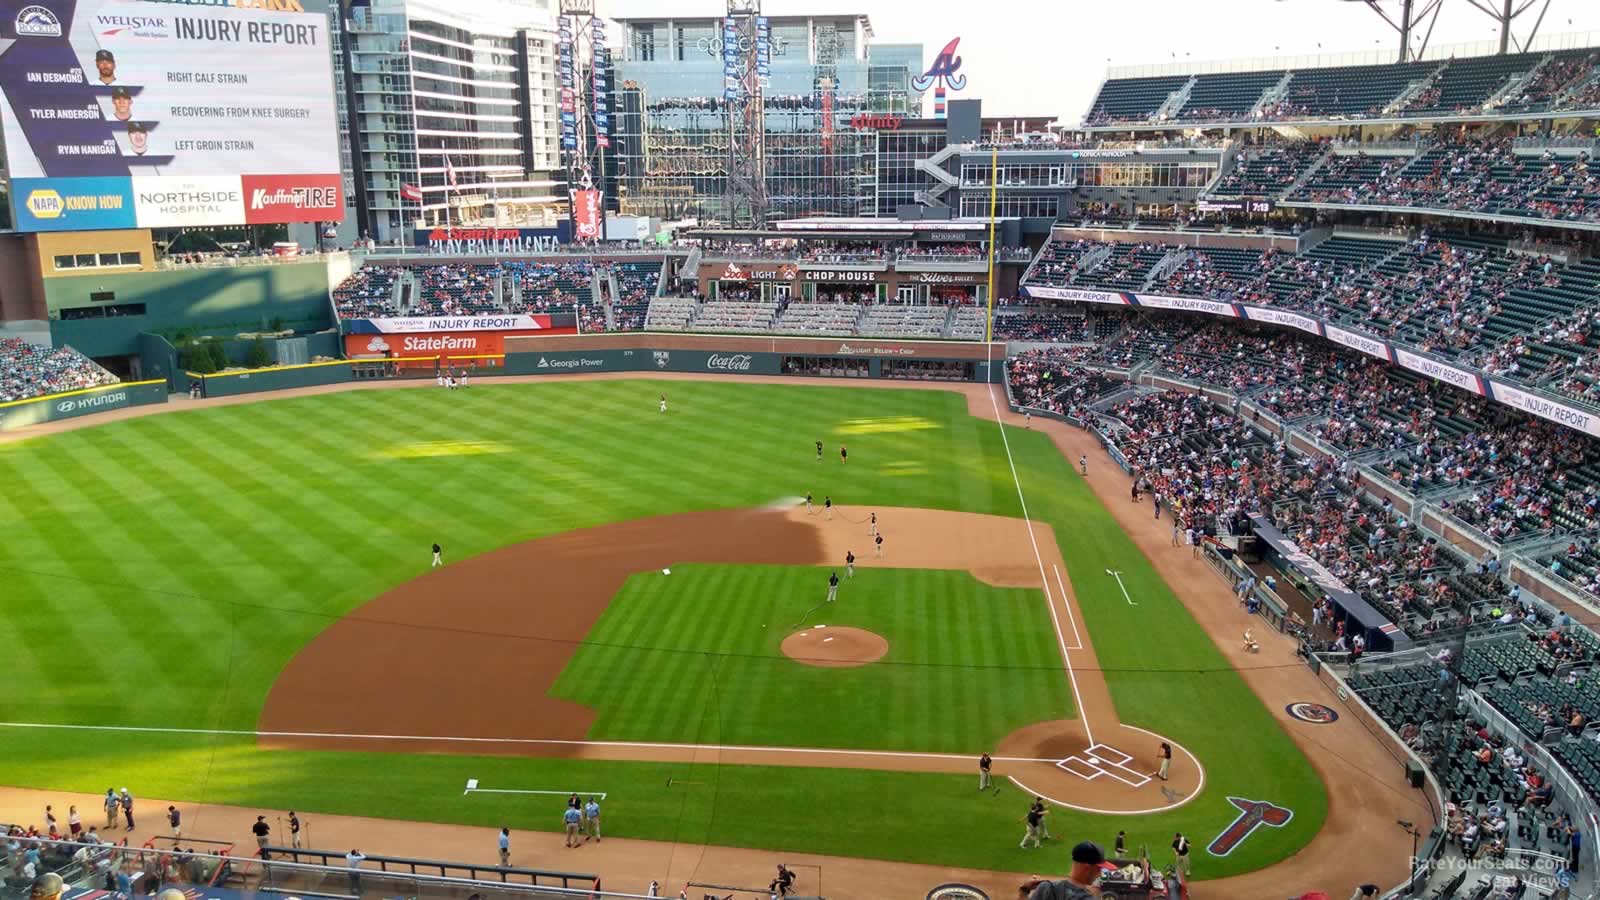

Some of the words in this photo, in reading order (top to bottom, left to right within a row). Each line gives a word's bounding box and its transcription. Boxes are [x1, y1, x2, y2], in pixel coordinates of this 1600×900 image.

[97, 15, 165, 29] WELLSTAR
[175, 17, 241, 42] INJURY
[248, 21, 317, 45] REPORT
[27, 72, 41, 82] IAN
[43, 72, 83, 83] DESMOND
[167, 71, 193, 83] RIGHT
[195, 73, 215, 83] CALF
[217, 73, 248, 84] STRAIN
[30, 109, 56, 119] TYLER
[57, 109, 100, 119] ANDERSON
[171, 106, 225, 117] RECOVERING
[226, 107, 250, 118] FROM
[252, 107, 273, 118] KNEE
[274, 108, 311, 119] SURGERY
[850, 112, 903, 130] xfinity
[58, 145, 80, 155] RYAN
[81, 145, 116, 155] HANIGAN
[175, 140, 194, 150] LEFT
[196, 140, 223, 150] GROIN
[224, 140, 255, 151] STRAIN
[33, 197, 59, 211] NAPA
[66, 196, 97, 210] KNOW
[99, 195, 123, 209] HOW
[140, 191, 239, 205] NORTHSIDE
[252, 188, 305, 209] Kauffman
[292, 187, 336, 209] TIRE
[160, 205, 222, 214] HOSPITAL
[1252, 203, 1269, 212] 7:13
[751, 270, 776, 279] LIGHT
[806, 271, 835, 280] CHOP
[838, 271, 875, 281] HOUSE
[920, 272, 953, 282] Silver
[1057, 290, 1082, 299] INJURY
[1083, 292, 1111, 301] REPORT
[1172, 300, 1199, 310] INJURY
[1200, 302, 1224, 312] REPORT
[429, 318, 471, 329] INJURY
[473, 318, 517, 328] REPORT
[404, 336, 476, 350] StateFarm
[550, 358, 579, 368] Georgia
[582, 359, 603, 367] Power
[707, 354, 752, 370] Coca-Cola
[1421, 361, 1442, 377] INJURY
[1443, 368, 1468, 386] REPORT
[79, 392, 126, 408] HYUNDAI
[1524, 397, 1553, 415] INJURY
[1554, 407, 1589, 428] REPORT
